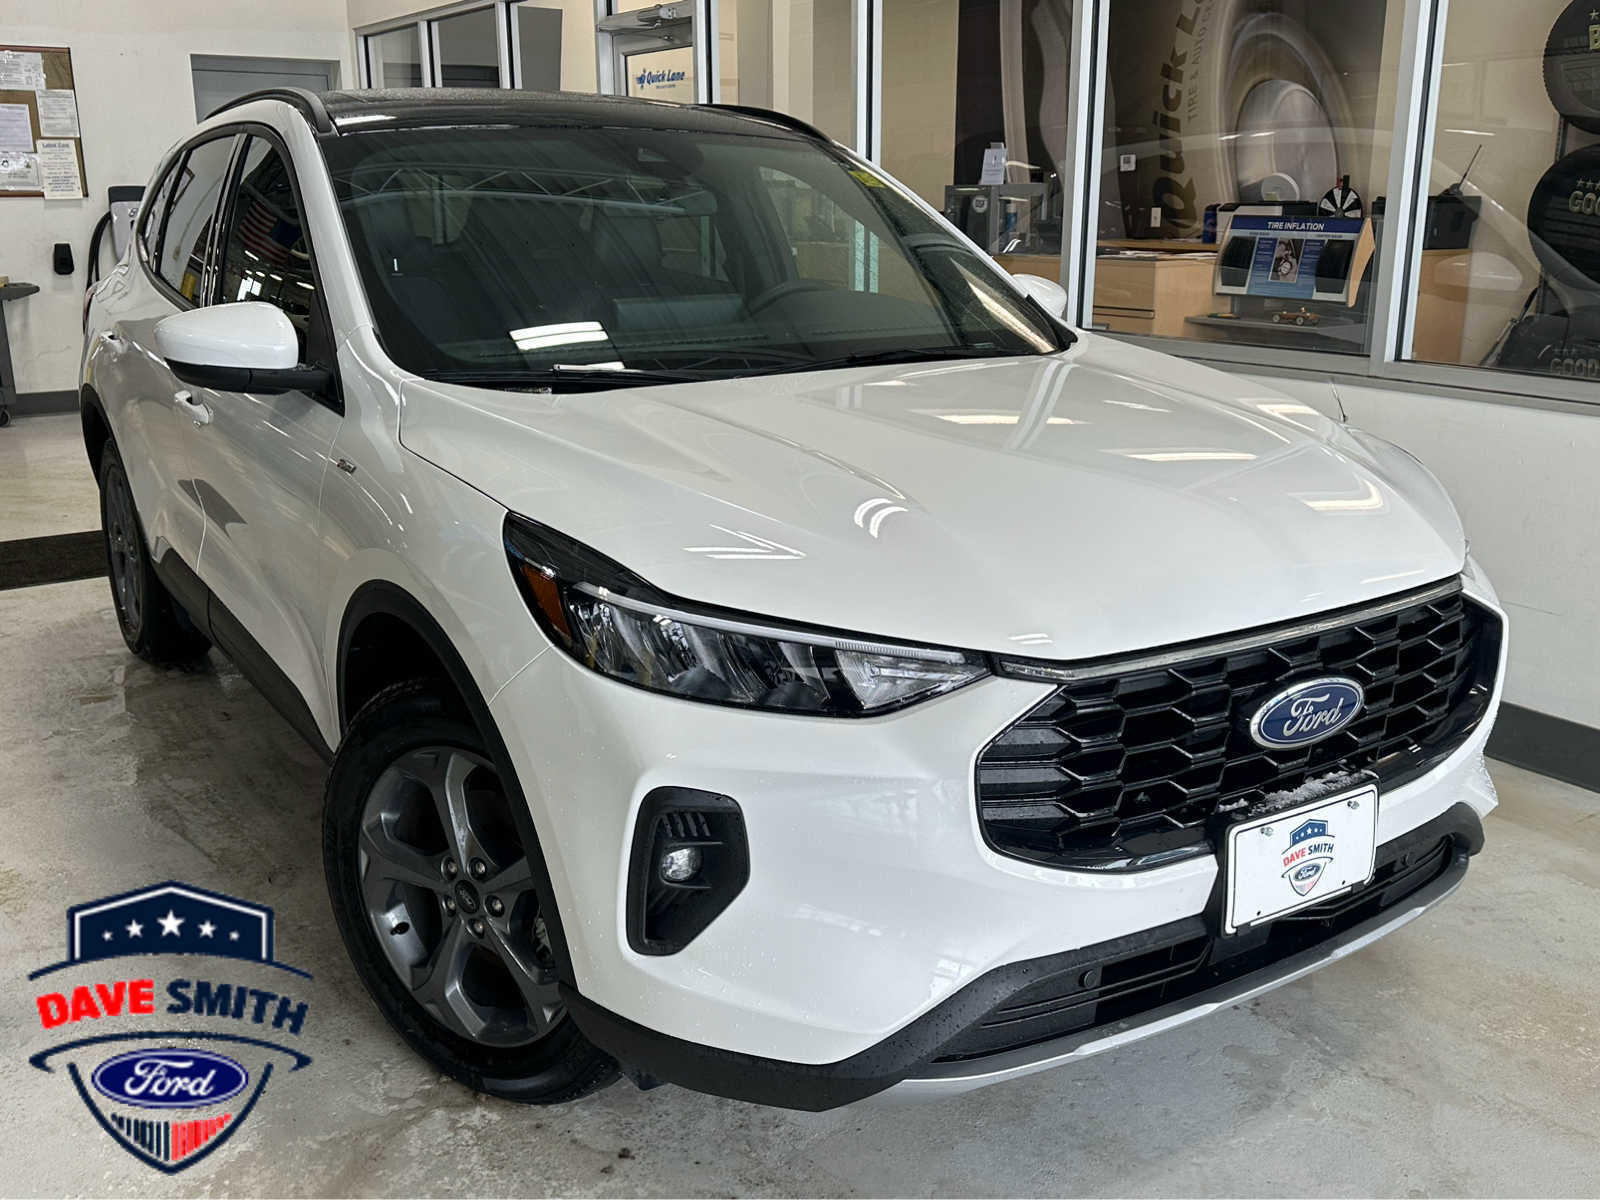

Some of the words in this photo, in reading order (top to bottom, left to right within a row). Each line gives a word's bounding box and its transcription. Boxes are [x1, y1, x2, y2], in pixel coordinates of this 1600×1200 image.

[647, 70, 665, 85] Quick
[667, 69, 685, 82] Lane
[1186, 86, 1200, 124] TIRE
[1267, 221, 1284, 230] TIRE
[1284, 222, 1325, 231] INFLATION
[1282, 693, 1344, 737] Ford
[1283, 847, 1307, 867] DAVE
[1308, 843, 1335, 855] SMITH
